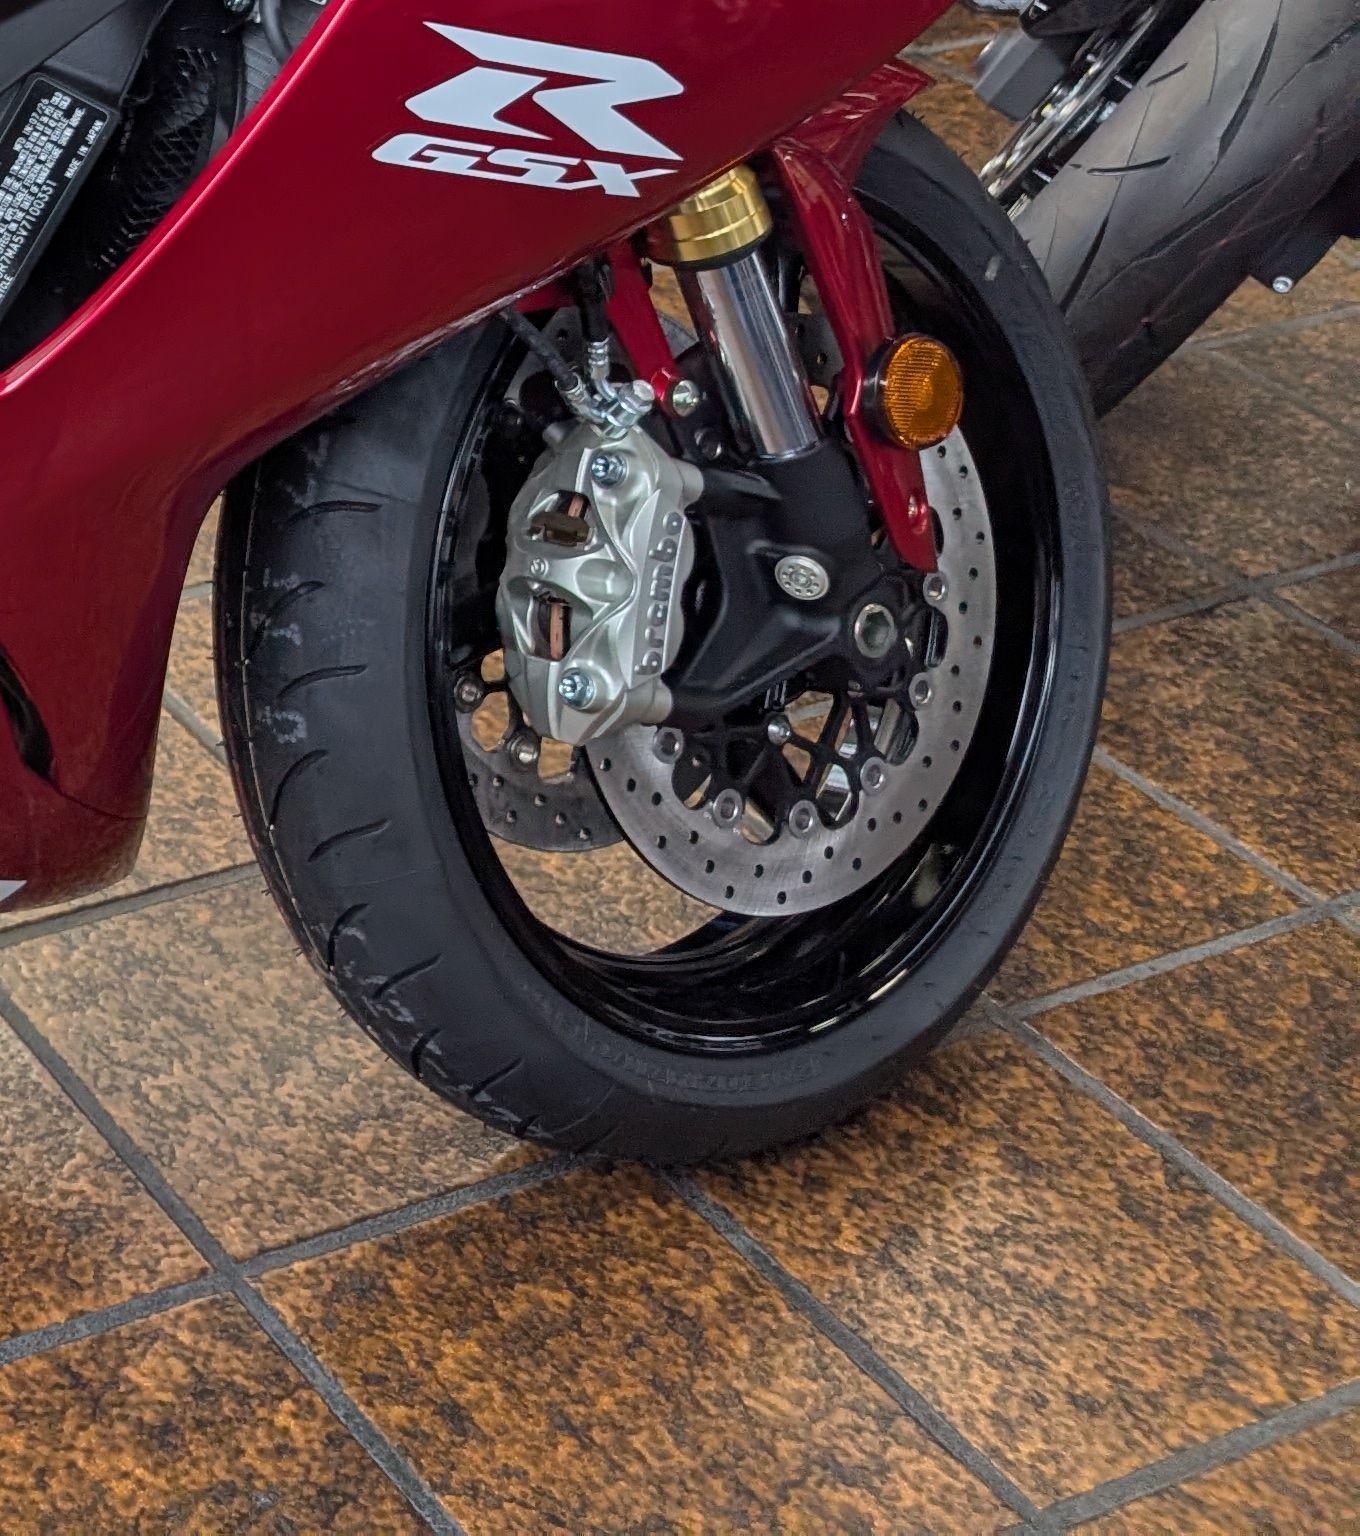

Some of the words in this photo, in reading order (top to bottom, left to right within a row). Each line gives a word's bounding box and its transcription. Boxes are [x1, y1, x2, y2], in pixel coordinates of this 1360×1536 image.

[405, 21, 685, 162] R
[63, 156, 82, 180] MADE
[76, 143, 89, 157] IN
[83, 117, 104, 145] JAPAN
[371, 132, 677, 198] GSX
[633, 510, 683, 678] brembo
